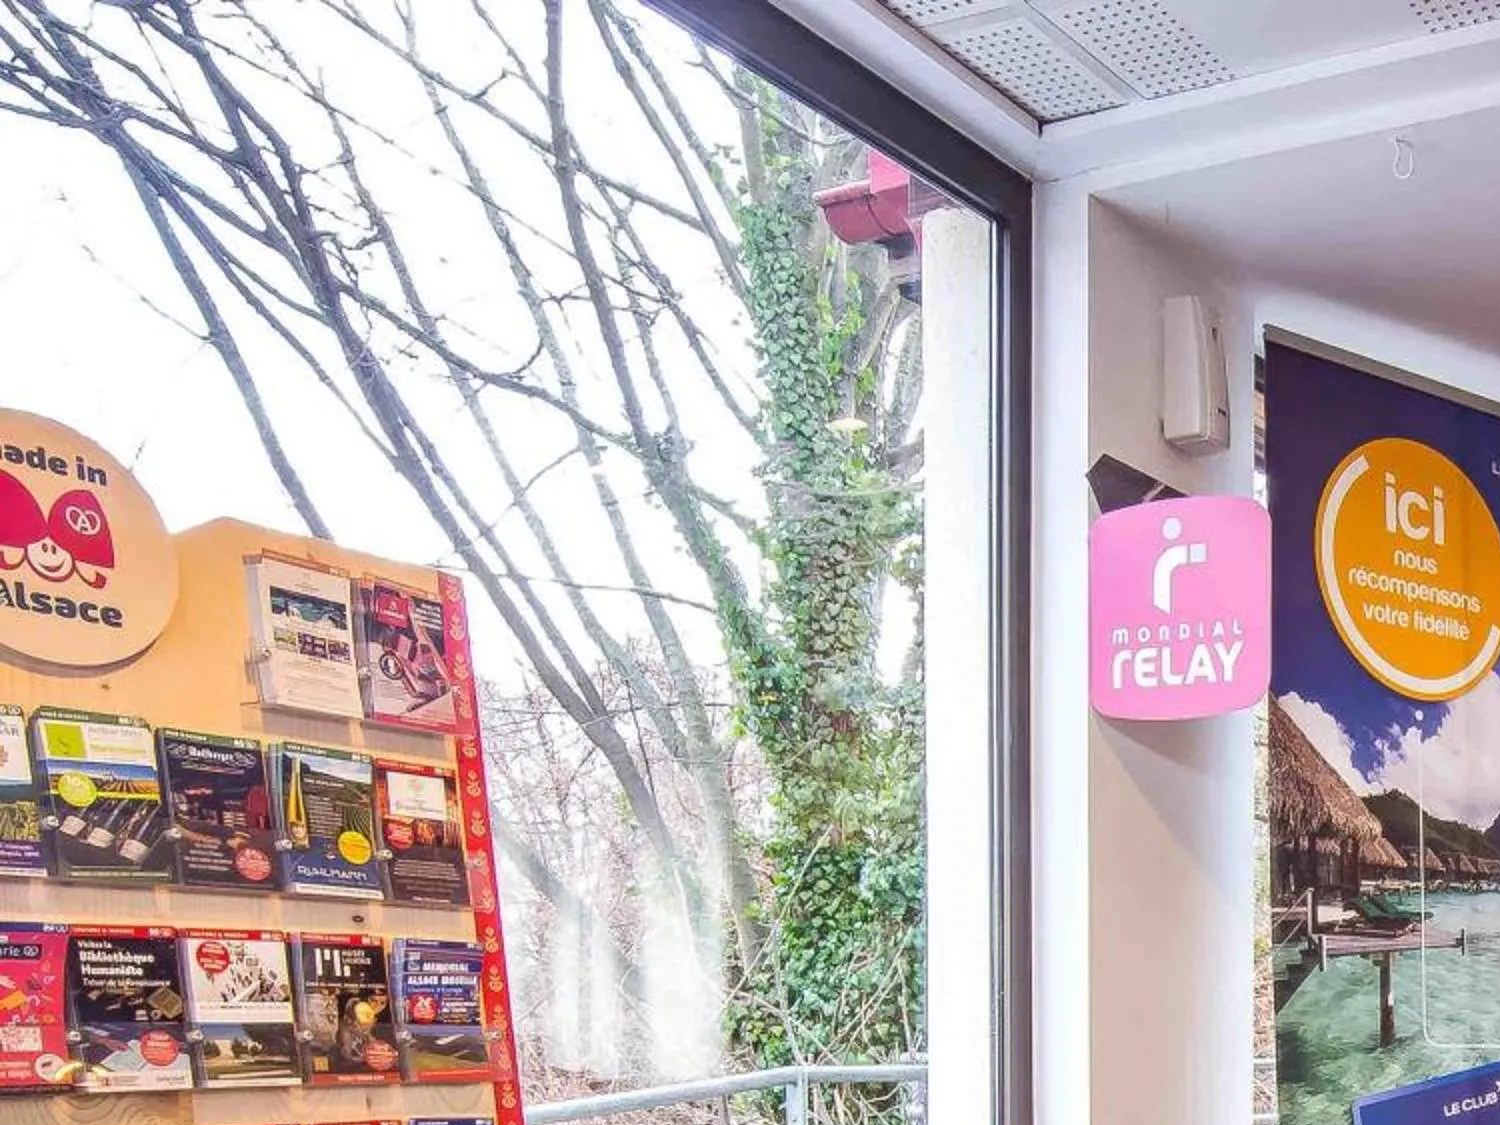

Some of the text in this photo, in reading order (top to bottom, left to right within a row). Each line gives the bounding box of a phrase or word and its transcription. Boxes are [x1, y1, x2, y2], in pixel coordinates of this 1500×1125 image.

[0, 442, 107, 487] ade in
[1384, 472, 1446, 545] ici
[1393, 548, 1438, 574] nous
[1347, 566, 1482, 613] récompensons
[1362, 601, 1409, 630] votre
[1443, 1101, 1460, 1118] LE
[1461, 1091, 1499, 1113] CLUB
